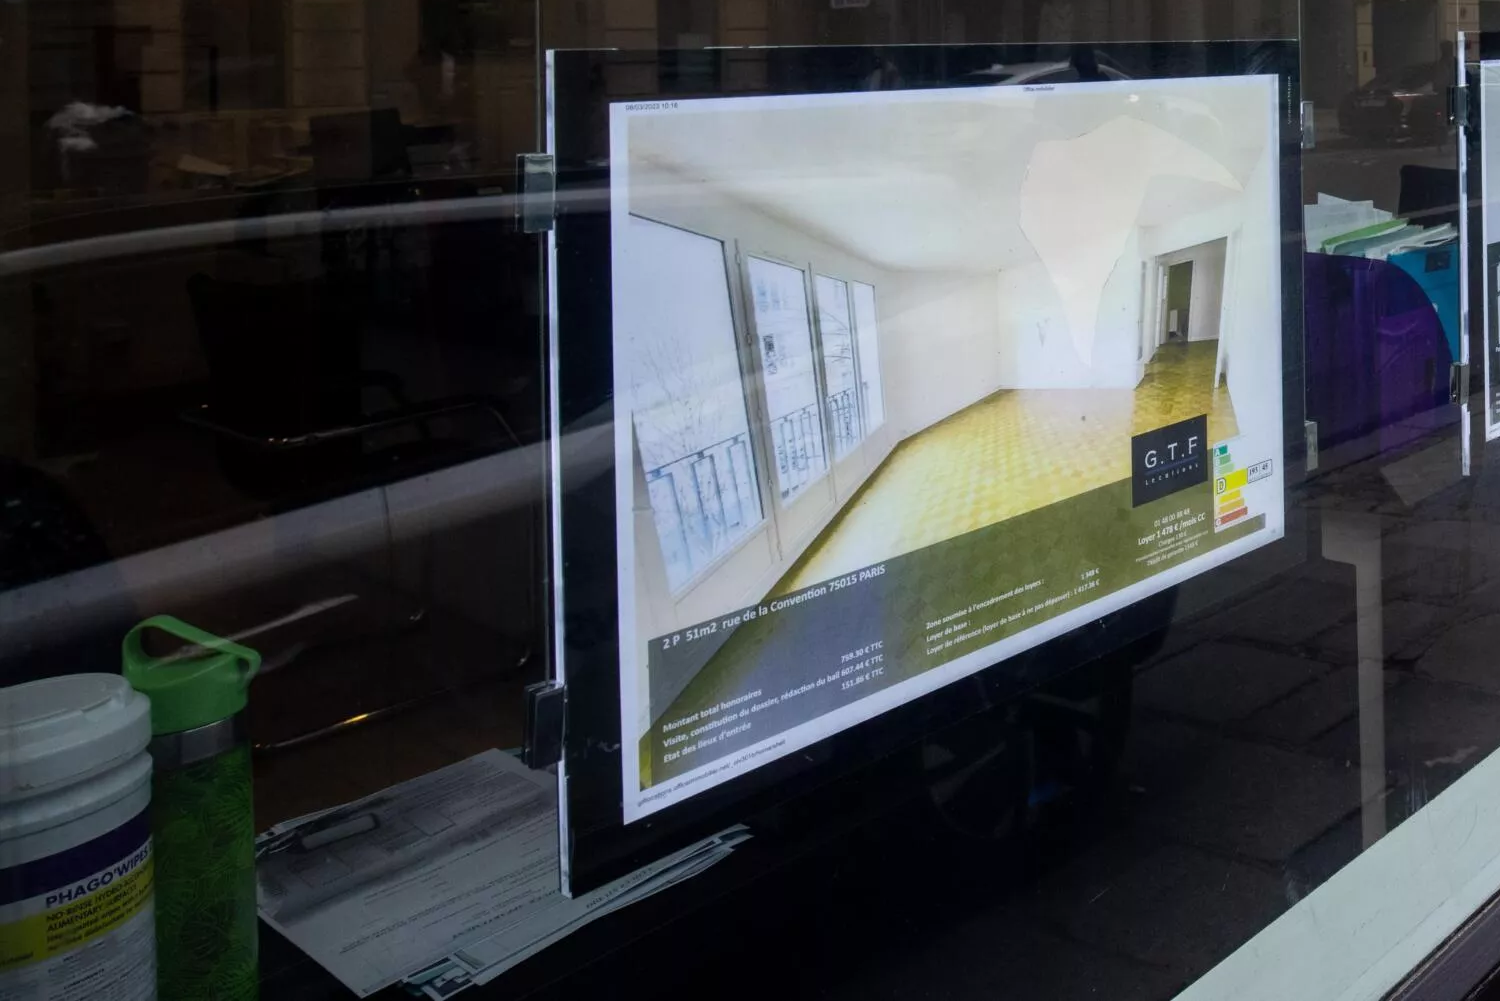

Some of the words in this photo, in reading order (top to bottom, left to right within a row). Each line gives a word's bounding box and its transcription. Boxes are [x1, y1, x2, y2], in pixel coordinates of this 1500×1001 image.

[1144, 436, 1198, 469] G.T.F
[1216, 478, 1226, 494] D
[1138, 533, 1156, 546] Loyer
[1197, 512, 1206, 522] CC
[662, 638, 670, 650] 2
[672, 635, 680, 647] P
[685, 623, 717, 642] 51m2
[722, 616, 741, 630] rue
[743, 608, 756, 622] de
[758, 604, 768, 618] la
[770, 587, 826, 612] Convention
[828, 575, 858, 591] 75015
[859, 564, 886, 582] PARIS
[926, 618, 942, 630] Zone
[871, 640, 884, 651] TTC
[926, 631, 943, 643] Loyer
[926, 644, 944, 656] Loyer
[871, 667, 884, 678] TTC
[662, 712, 699, 733] Montant
[700, 704, 719, 718] total
[720, 688, 763, 710] honoraires
[663, 733, 689, 749] Visite,
[690, 712, 738, 738] constitution
[739, 706, 750, 718] du
[751, 696, 779, 716] dossier,
[780, 684, 815, 704] rédaction
[816, 676, 826, 688] du
[827, 669, 840, 684] bail
[871, 654, 884, 664] TTC
[663, 751, 680, 764] Etat
[682, 742, 696, 756] des
[698, 735, 718, 751] lieux
[719, 722, 752, 741] d'entrée
